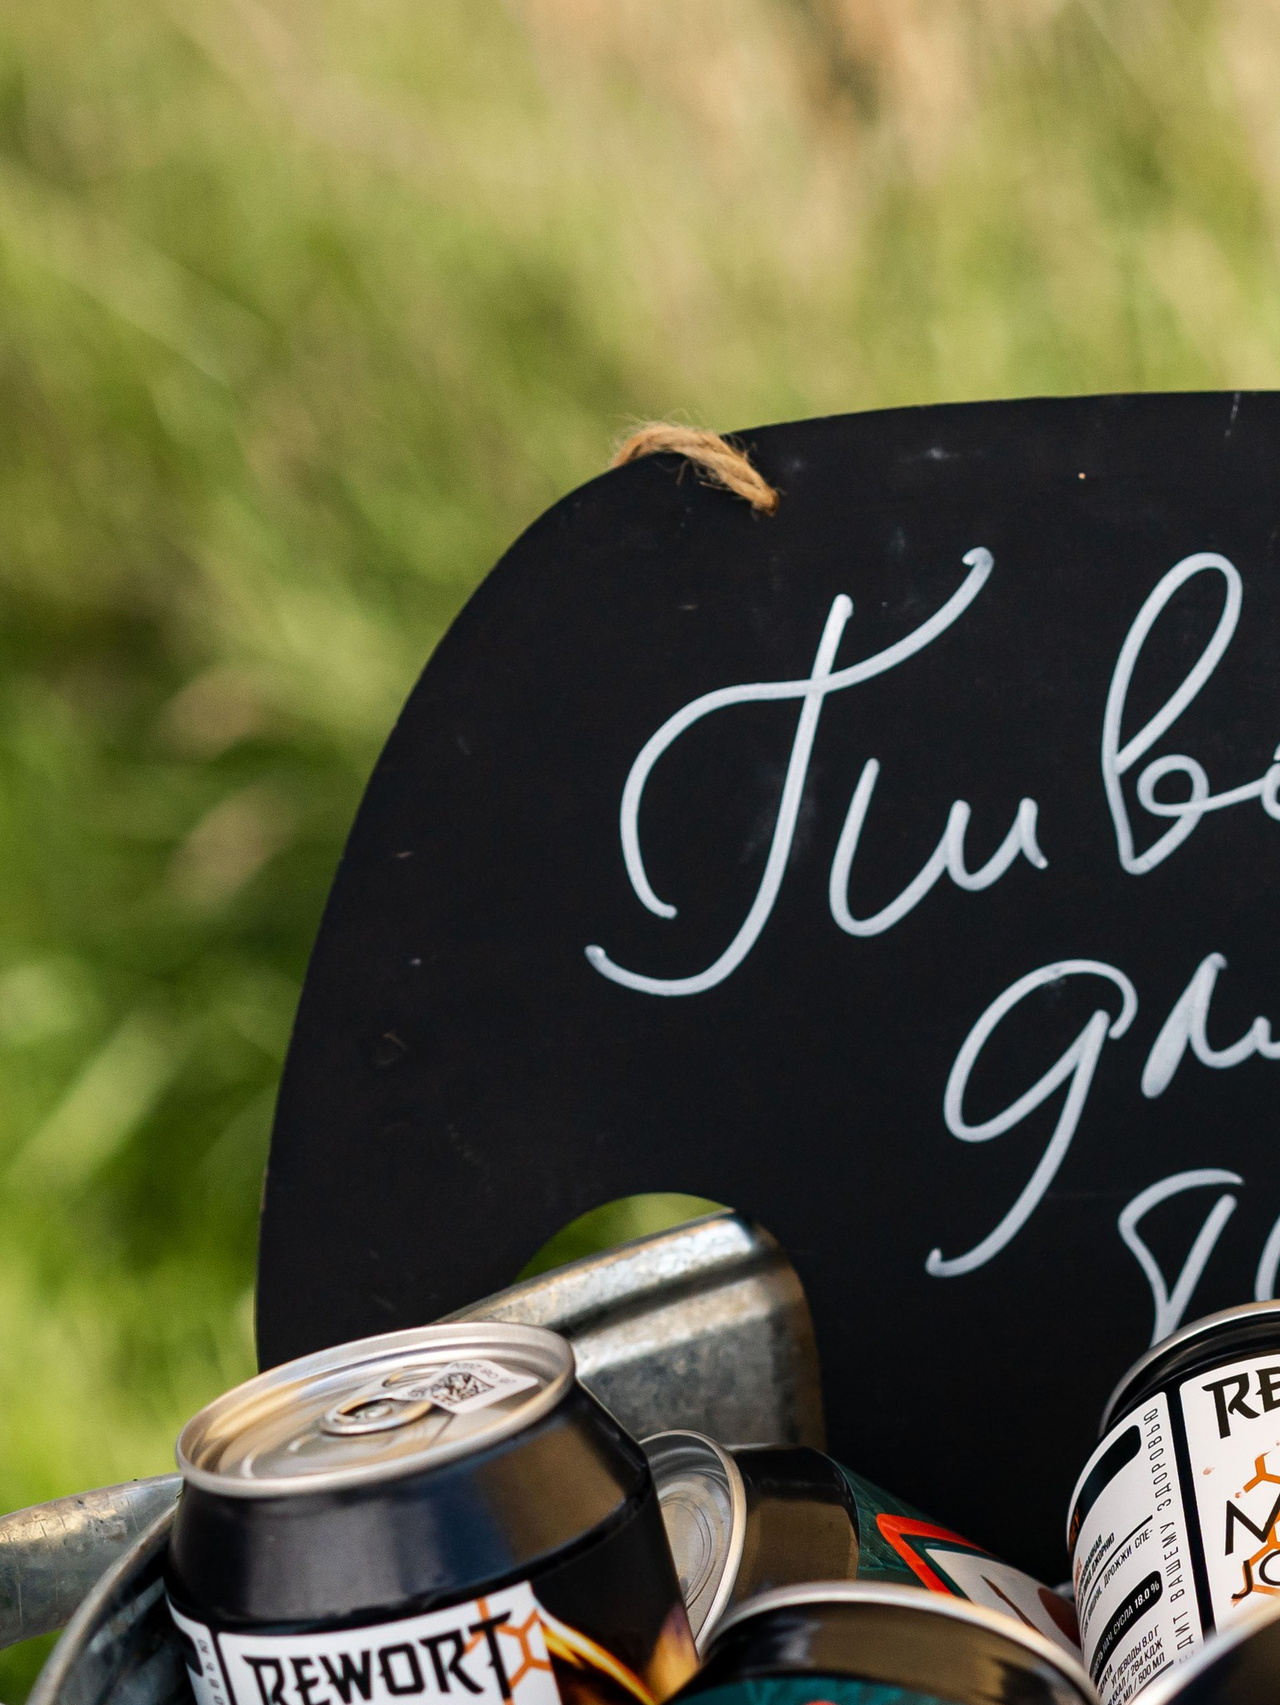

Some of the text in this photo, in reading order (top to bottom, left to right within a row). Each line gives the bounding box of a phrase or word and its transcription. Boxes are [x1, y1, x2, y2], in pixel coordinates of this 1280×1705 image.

[1143, 1407, 1173, 1512] ЗДОРОВЬЮ
[1104, 1545, 1133, 1588] ДРОЖЖИ
[1134, 1528, 1154, 1549] СПЕ-
[1160, 1520, 1186, 1604] ВАШЕМУ
[1134, 1588, 1151, 1609] 18.0
[1151, 1580, 1160, 1594] %
[1110, 1642, 1142, 1688] УГЛЕВОДЫ
[1141, 1631, 1154, 1650] 8.0
[1138, 1665, 1153, 1685] 500
[1152, 1651, 1166, 1671] МЛ
[1144, 1637, 1164, 1663] КДЖ
